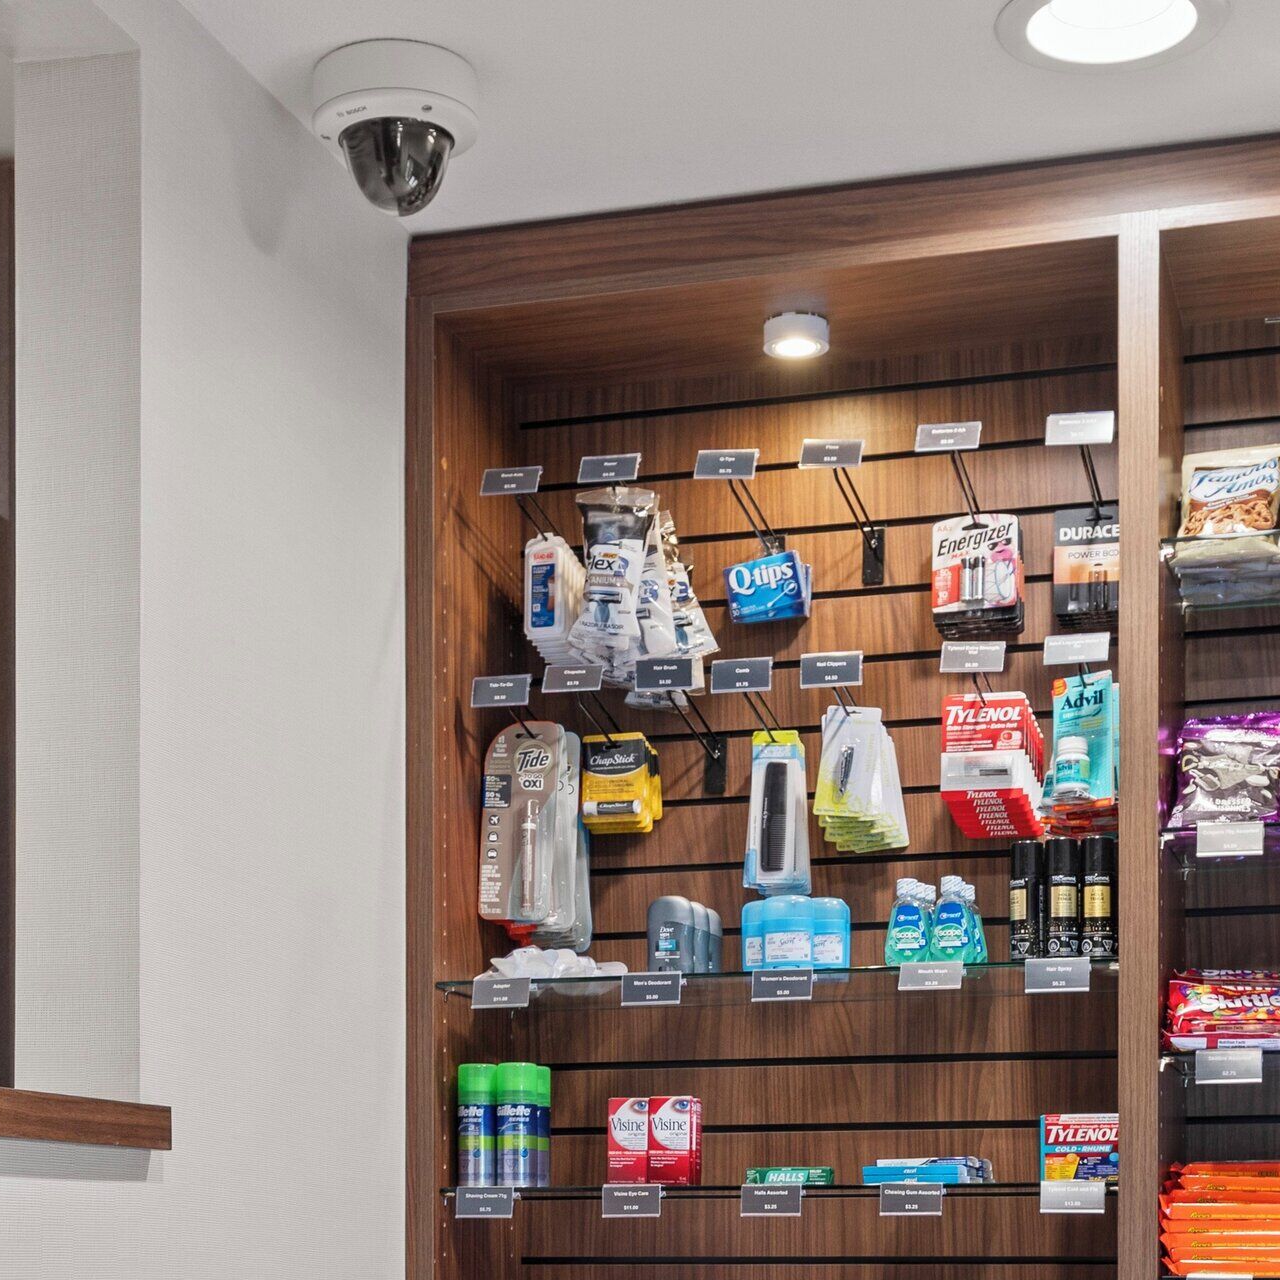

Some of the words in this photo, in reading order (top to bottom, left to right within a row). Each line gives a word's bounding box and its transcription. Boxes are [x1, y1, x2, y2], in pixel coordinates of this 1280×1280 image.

[1193, 456, 1280, 485] Famous
[1217, 474, 1280, 499] Amos
[935, 521, 1013, 557] Energizer
[728, 560, 795, 596] Q-tips
[1060, 689, 1104, 713] Advil
[945, 705, 1022, 725] TYLENOL
[516, 749, 549, 773] Tide
[590, 752, 636, 767] ChapStick
[522, 779, 542, 789] OXI
[966, 790, 999, 799] TYLENOL
[497, 1105, 532, 1118] Gillette
[611, 1117, 646, 1132] Visine
[651, 1117, 688, 1132] Visine
[1047, 1125, 1119, 1144] TYLENOL
[1055, 1145, 1078, 1153] COLD
[768, 1172, 805, 1184] HALLS
[884, 1189, 904, 1197] Chewing
